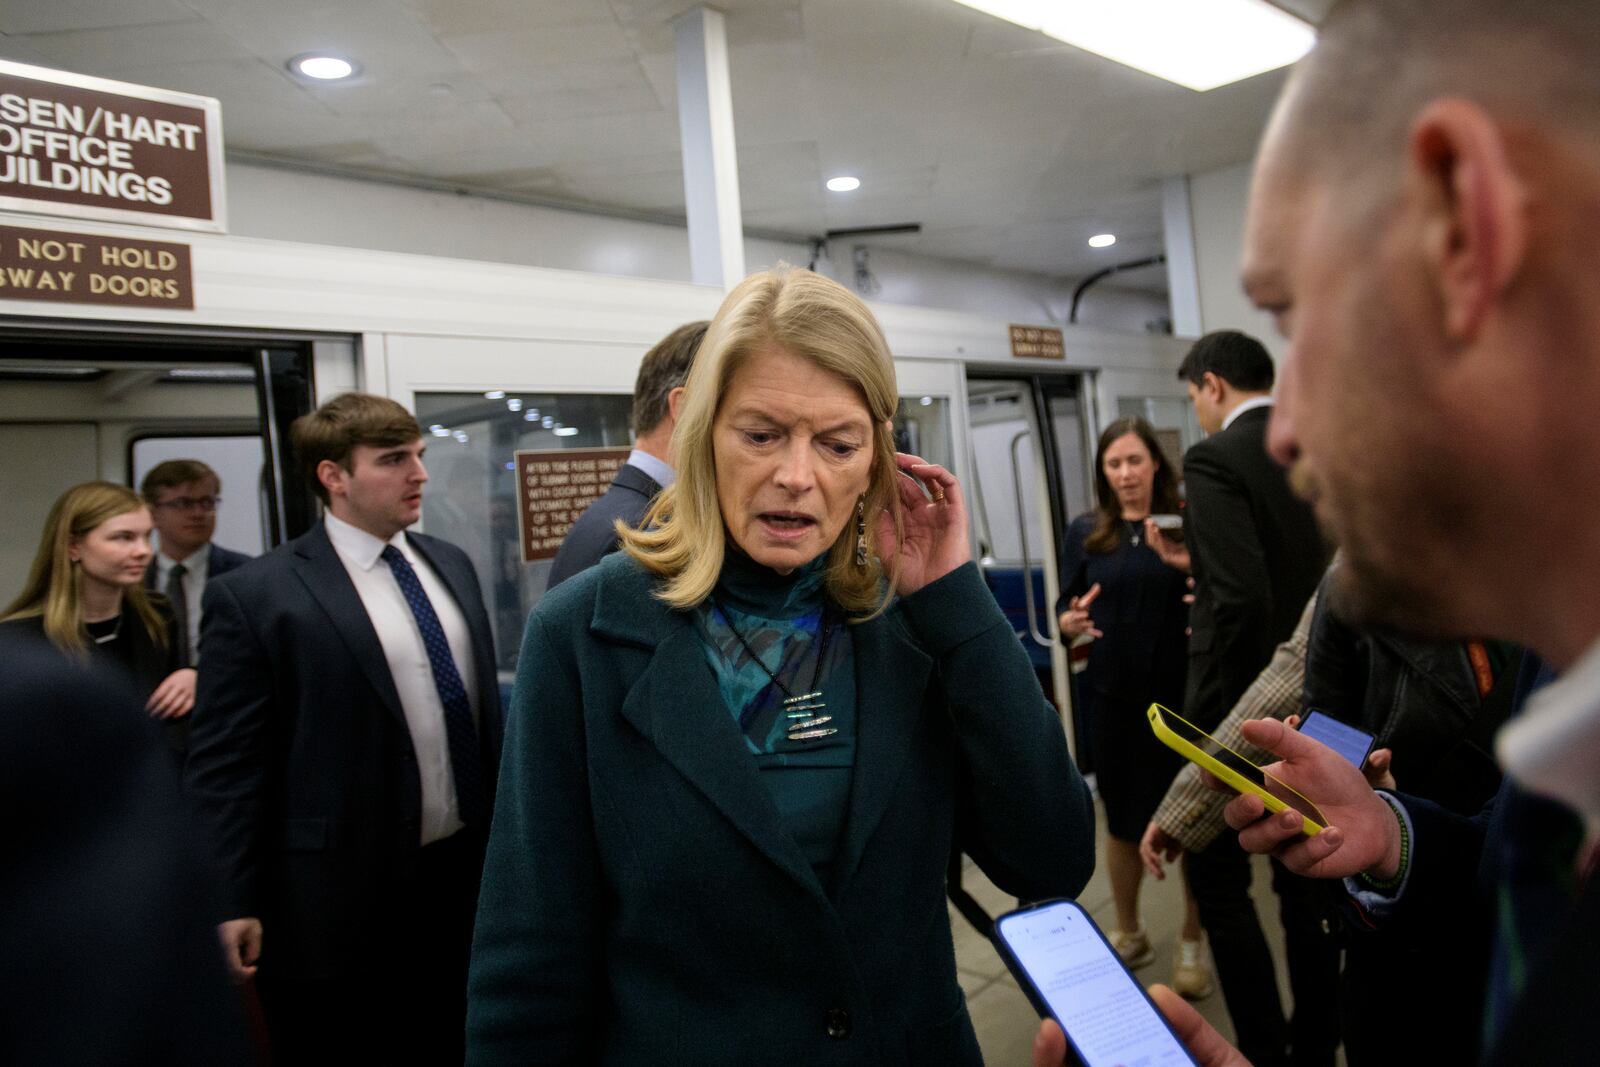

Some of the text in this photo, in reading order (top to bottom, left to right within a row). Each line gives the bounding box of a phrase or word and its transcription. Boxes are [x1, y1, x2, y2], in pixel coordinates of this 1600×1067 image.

[0, 123, 135, 170] OFFICE
[18, 238, 86, 263] NOT
[101, 245, 178, 271] HOLD
[89, 273, 180, 299] DOORS
[571, 460, 596, 471] PLEASE
[528, 487, 551, 499] WITH
[580, 484, 597, 496] MAY
